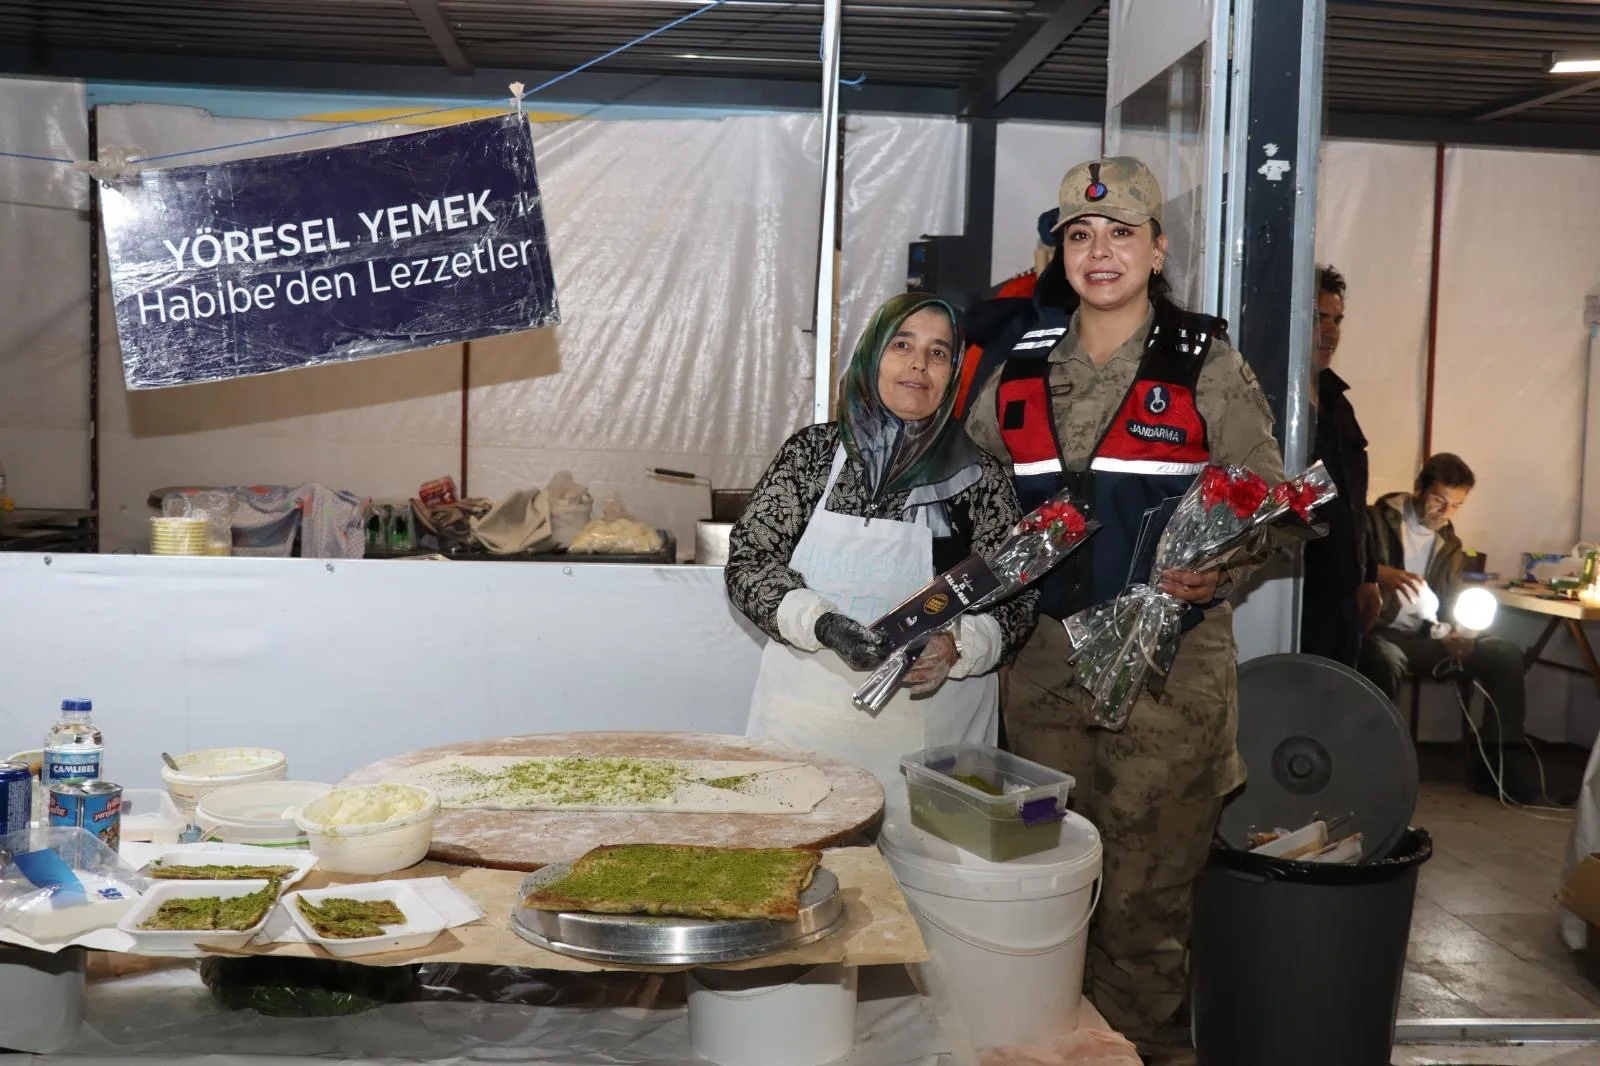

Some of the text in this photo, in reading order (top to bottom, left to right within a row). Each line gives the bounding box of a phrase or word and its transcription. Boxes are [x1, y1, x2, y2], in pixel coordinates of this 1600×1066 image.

[163, 190, 495, 271] YÖRESEL YEMEK
[137, 238, 533, 326] Habibe'den Lezzetler
[1129, 424, 1179, 442] JANDARMA
